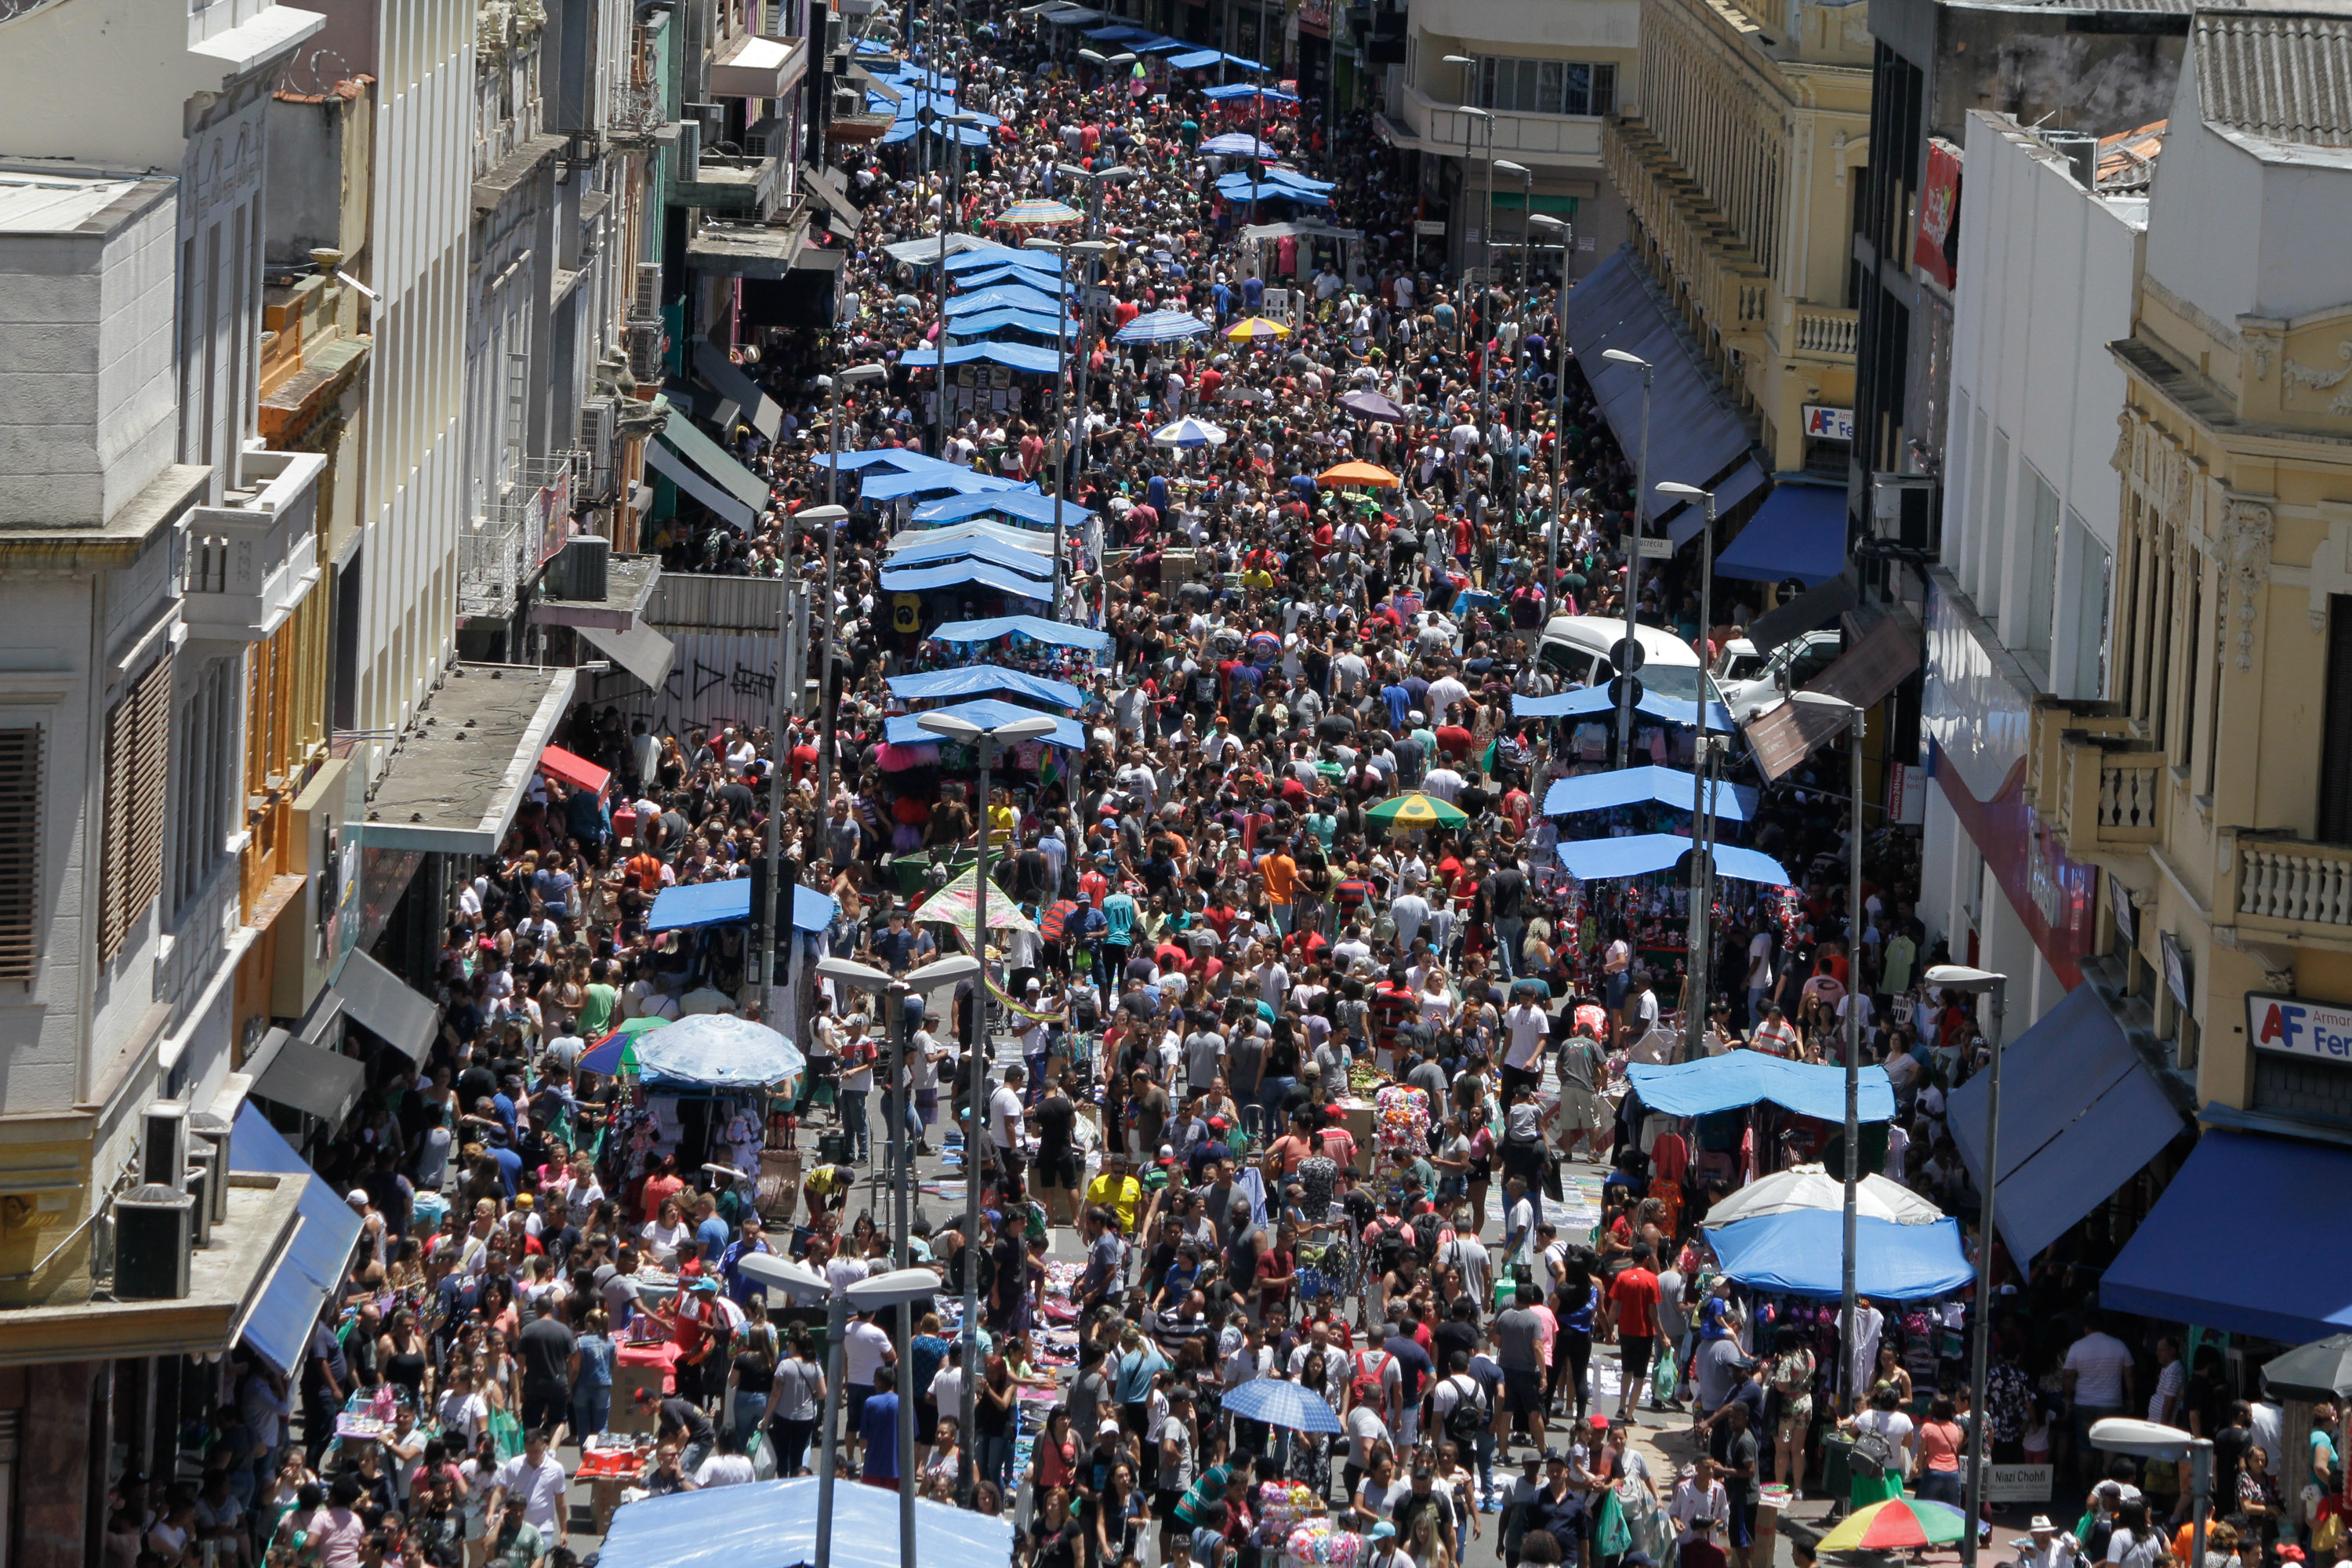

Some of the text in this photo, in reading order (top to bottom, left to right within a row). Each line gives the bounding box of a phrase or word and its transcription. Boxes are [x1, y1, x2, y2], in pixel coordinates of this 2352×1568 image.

[1809, 409, 1835, 434] AF
[1639, 539, 1664, 548] ucrécia
[1113, 908, 1127, 924] 11
[1385, 1007, 1391, 1025] 1
[2314, 1010, 2352, 1026] Armar
[2260, 1003, 2307, 1048] AF
[1995, 1471, 2045, 1483] Niazi Chohfi
